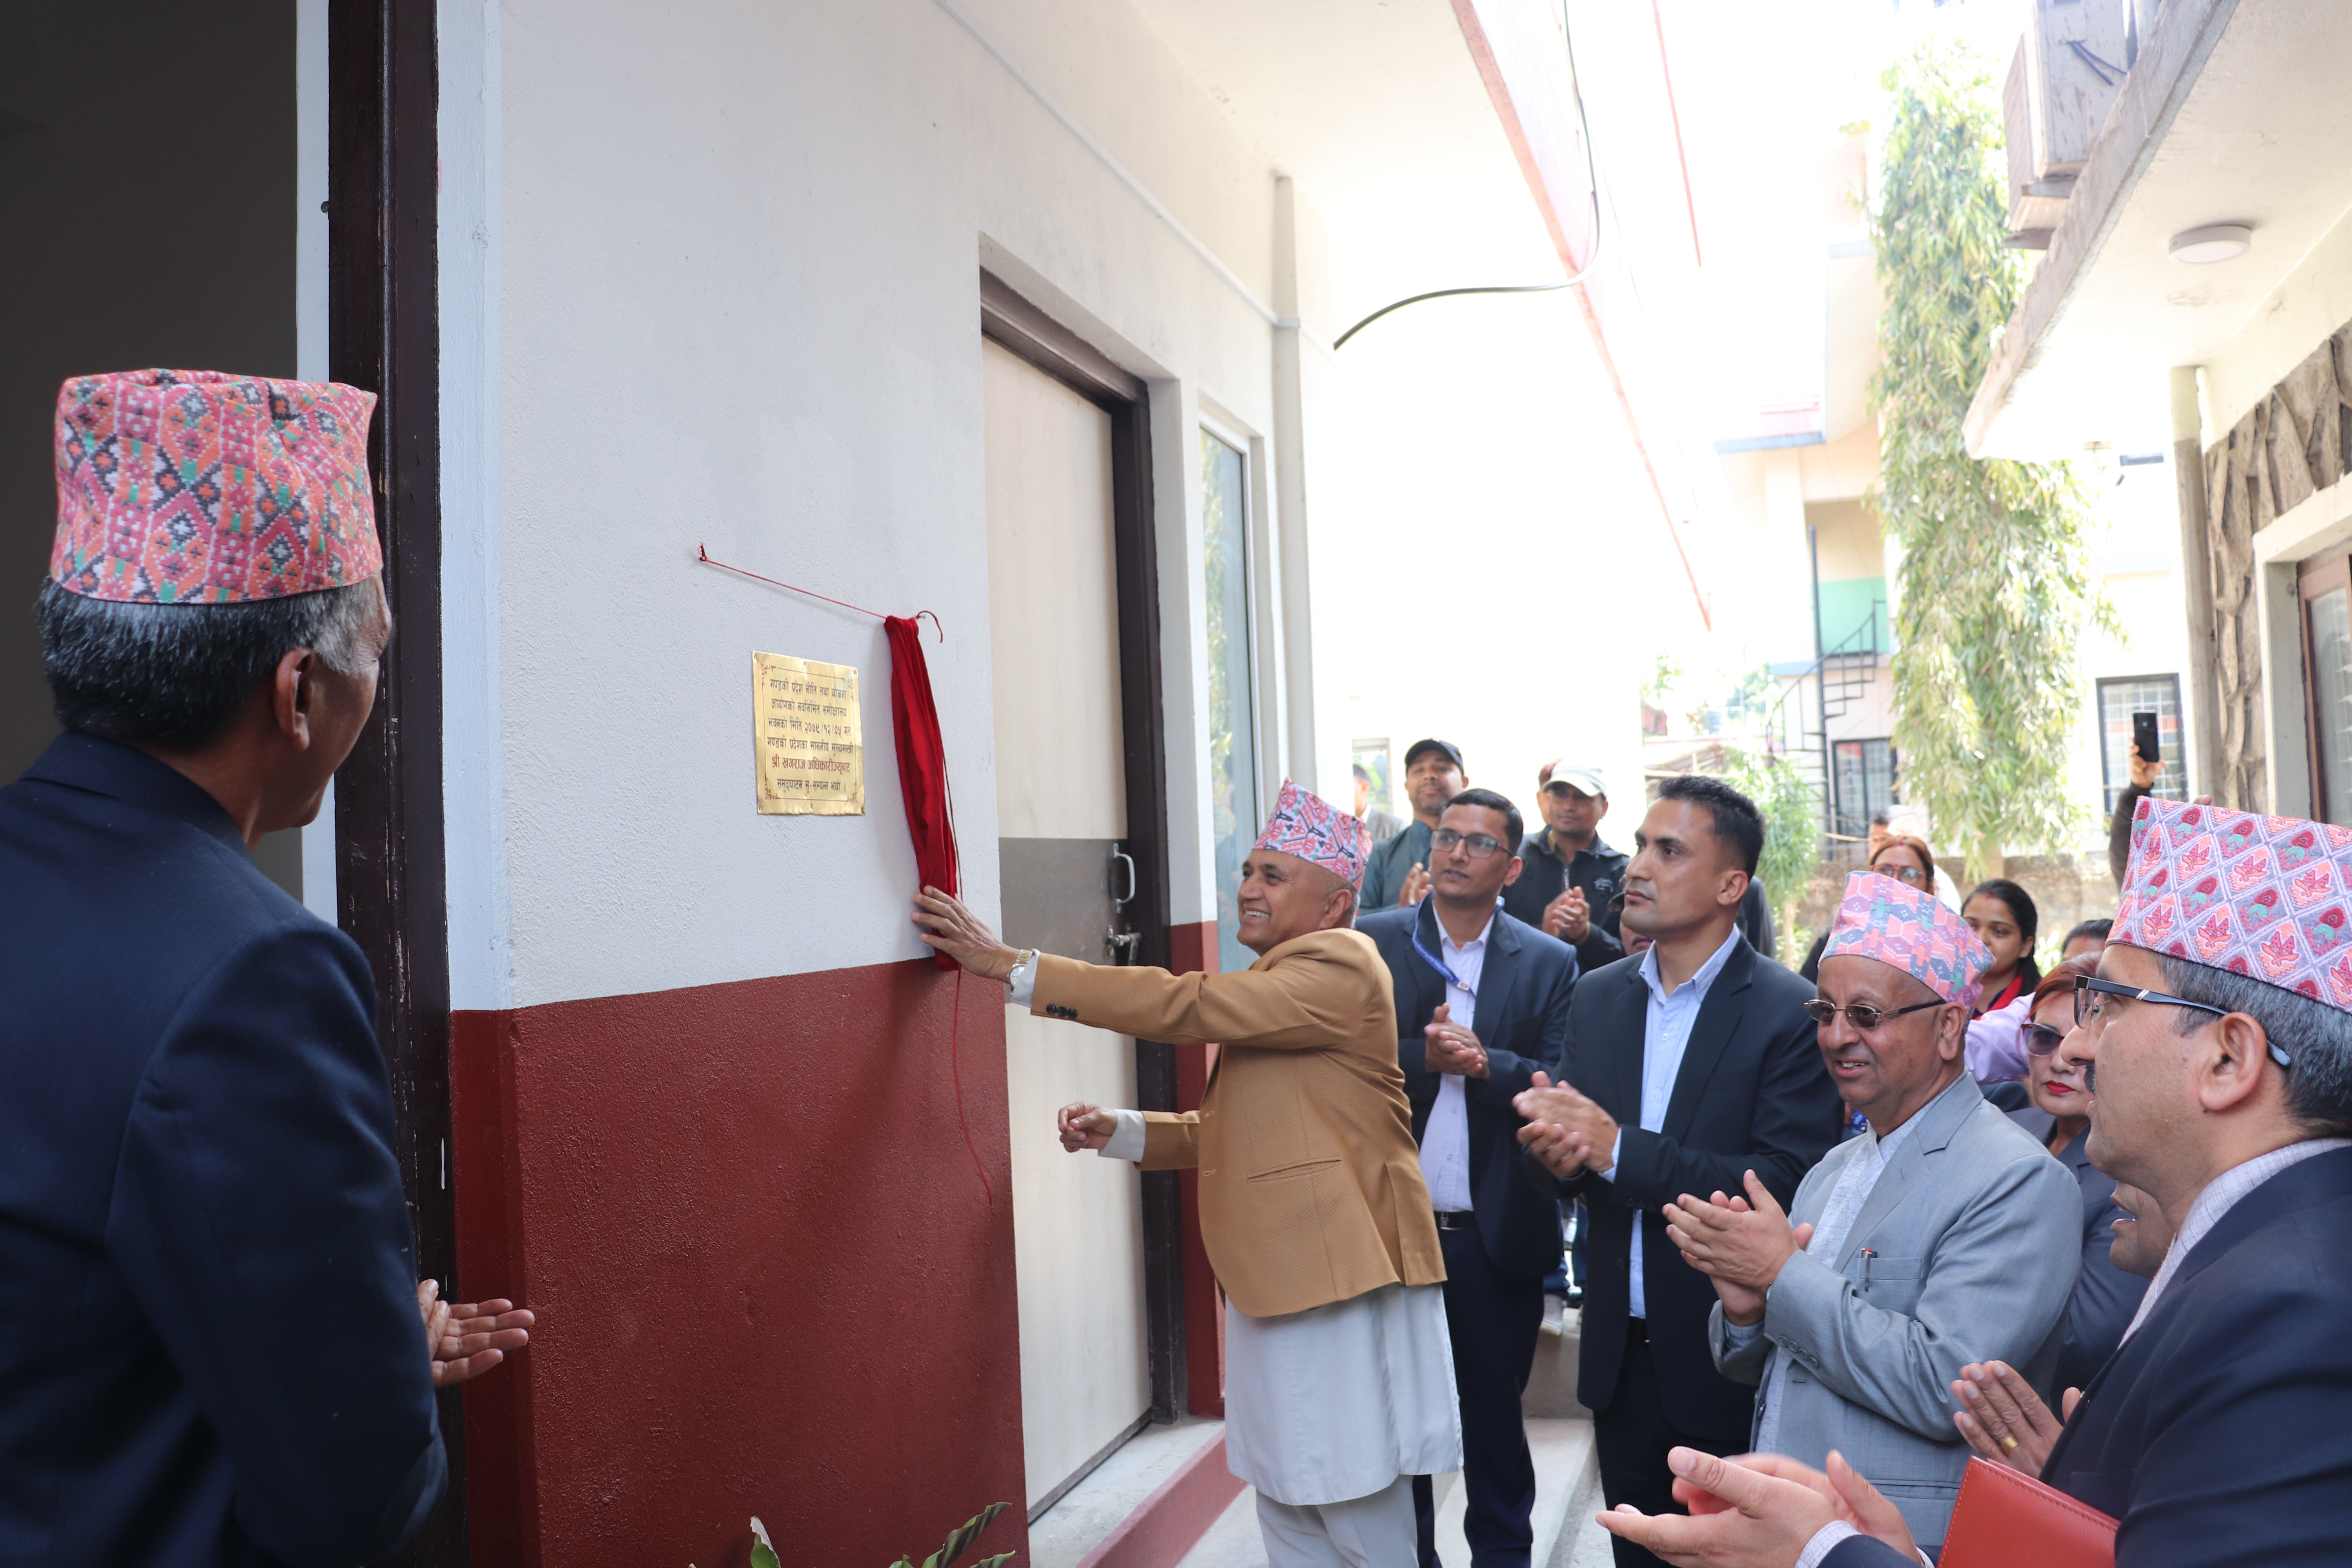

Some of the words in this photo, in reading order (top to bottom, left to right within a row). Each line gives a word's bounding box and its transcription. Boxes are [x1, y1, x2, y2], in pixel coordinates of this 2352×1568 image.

[770, 678, 789, 691] गण्डकी
[791, 680, 803, 694] प्रदेश
[806, 681, 817, 695] नीति
[819, 686, 829, 697] तथा
[831, 686, 846, 699] योजना
[771, 697, 795, 711] आयोगको
[768, 716, 787, 729] भवनको
[790, 716, 802, 731] मिति
[767, 735, 786, 748] गण्डकी
[789, 736, 808, 751] प्रदेशका
[810, 739, 829, 752] माननीय
[831, 741, 853, 756] मुख्यमन्त्री
[782, 757, 805, 769] खगराज
[807, 757, 850, 775] अधिकारीज्यूबाट
[831, 779, 841, 791] भयो
